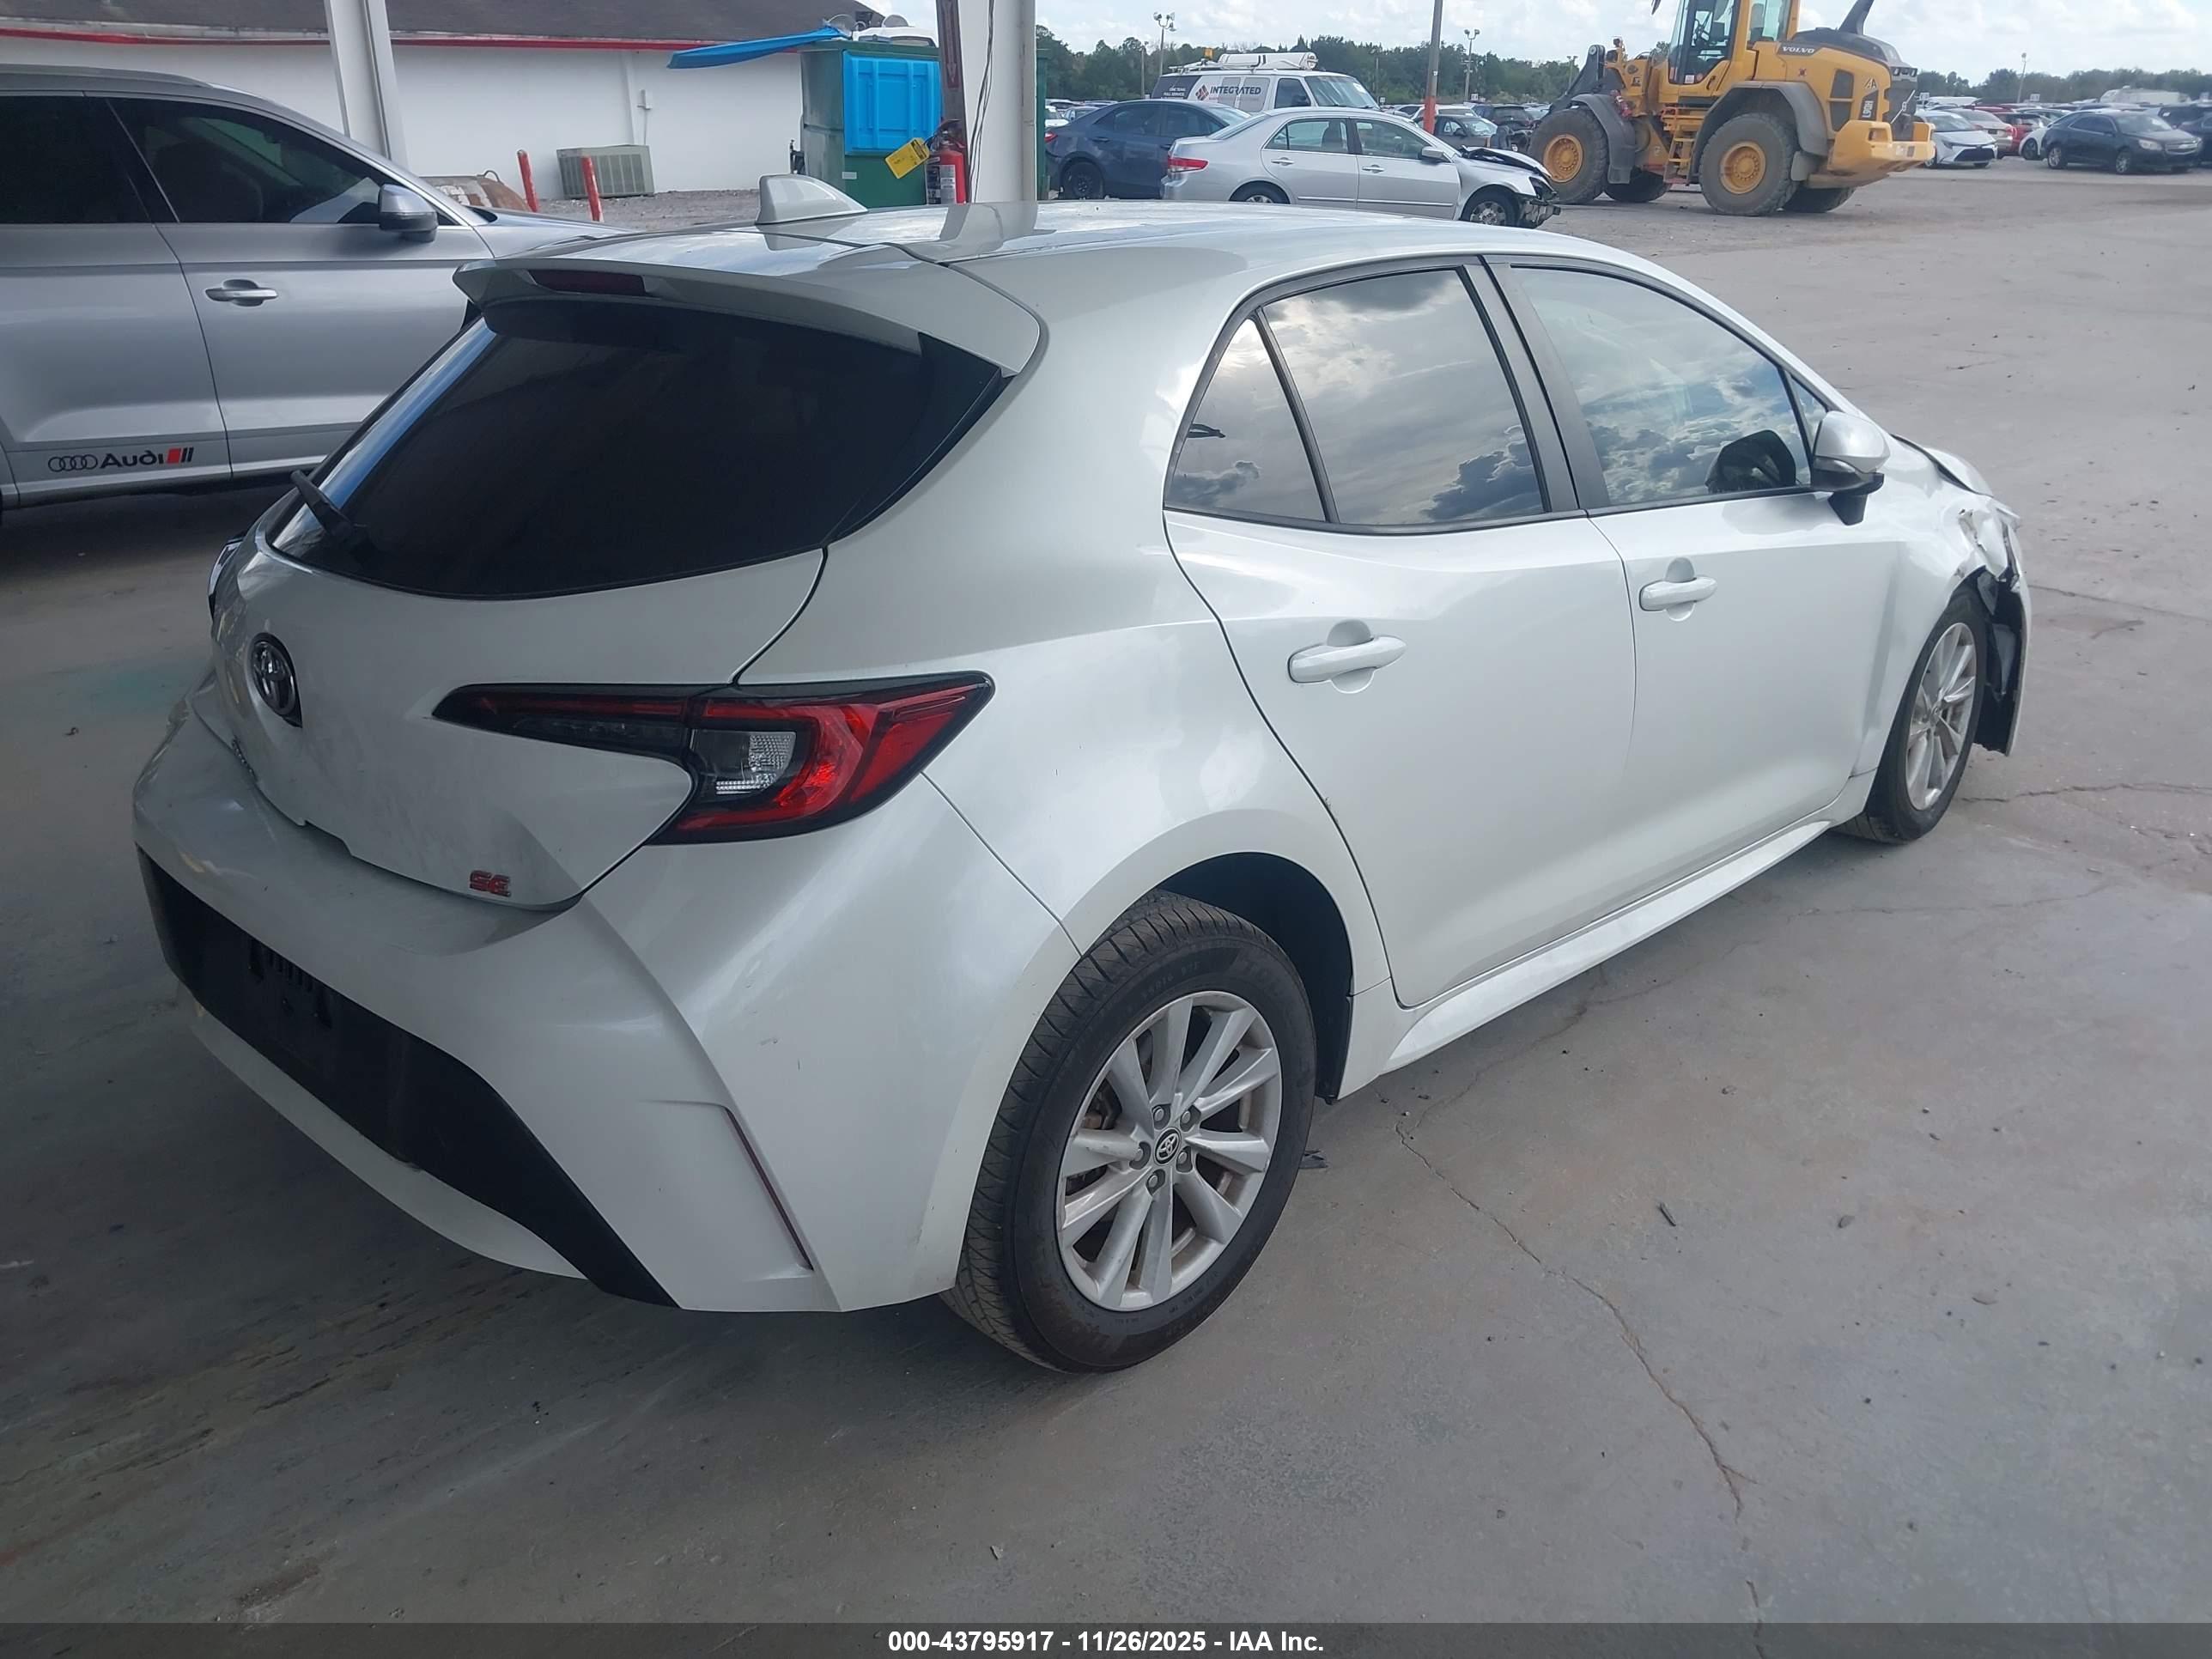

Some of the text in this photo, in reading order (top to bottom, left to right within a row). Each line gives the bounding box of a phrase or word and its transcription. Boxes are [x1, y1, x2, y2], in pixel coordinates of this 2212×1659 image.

[1210, 86, 1261, 95] INTEGRATED
[99, 450, 164, 469] Audi
[469, 870, 510, 897] SE
